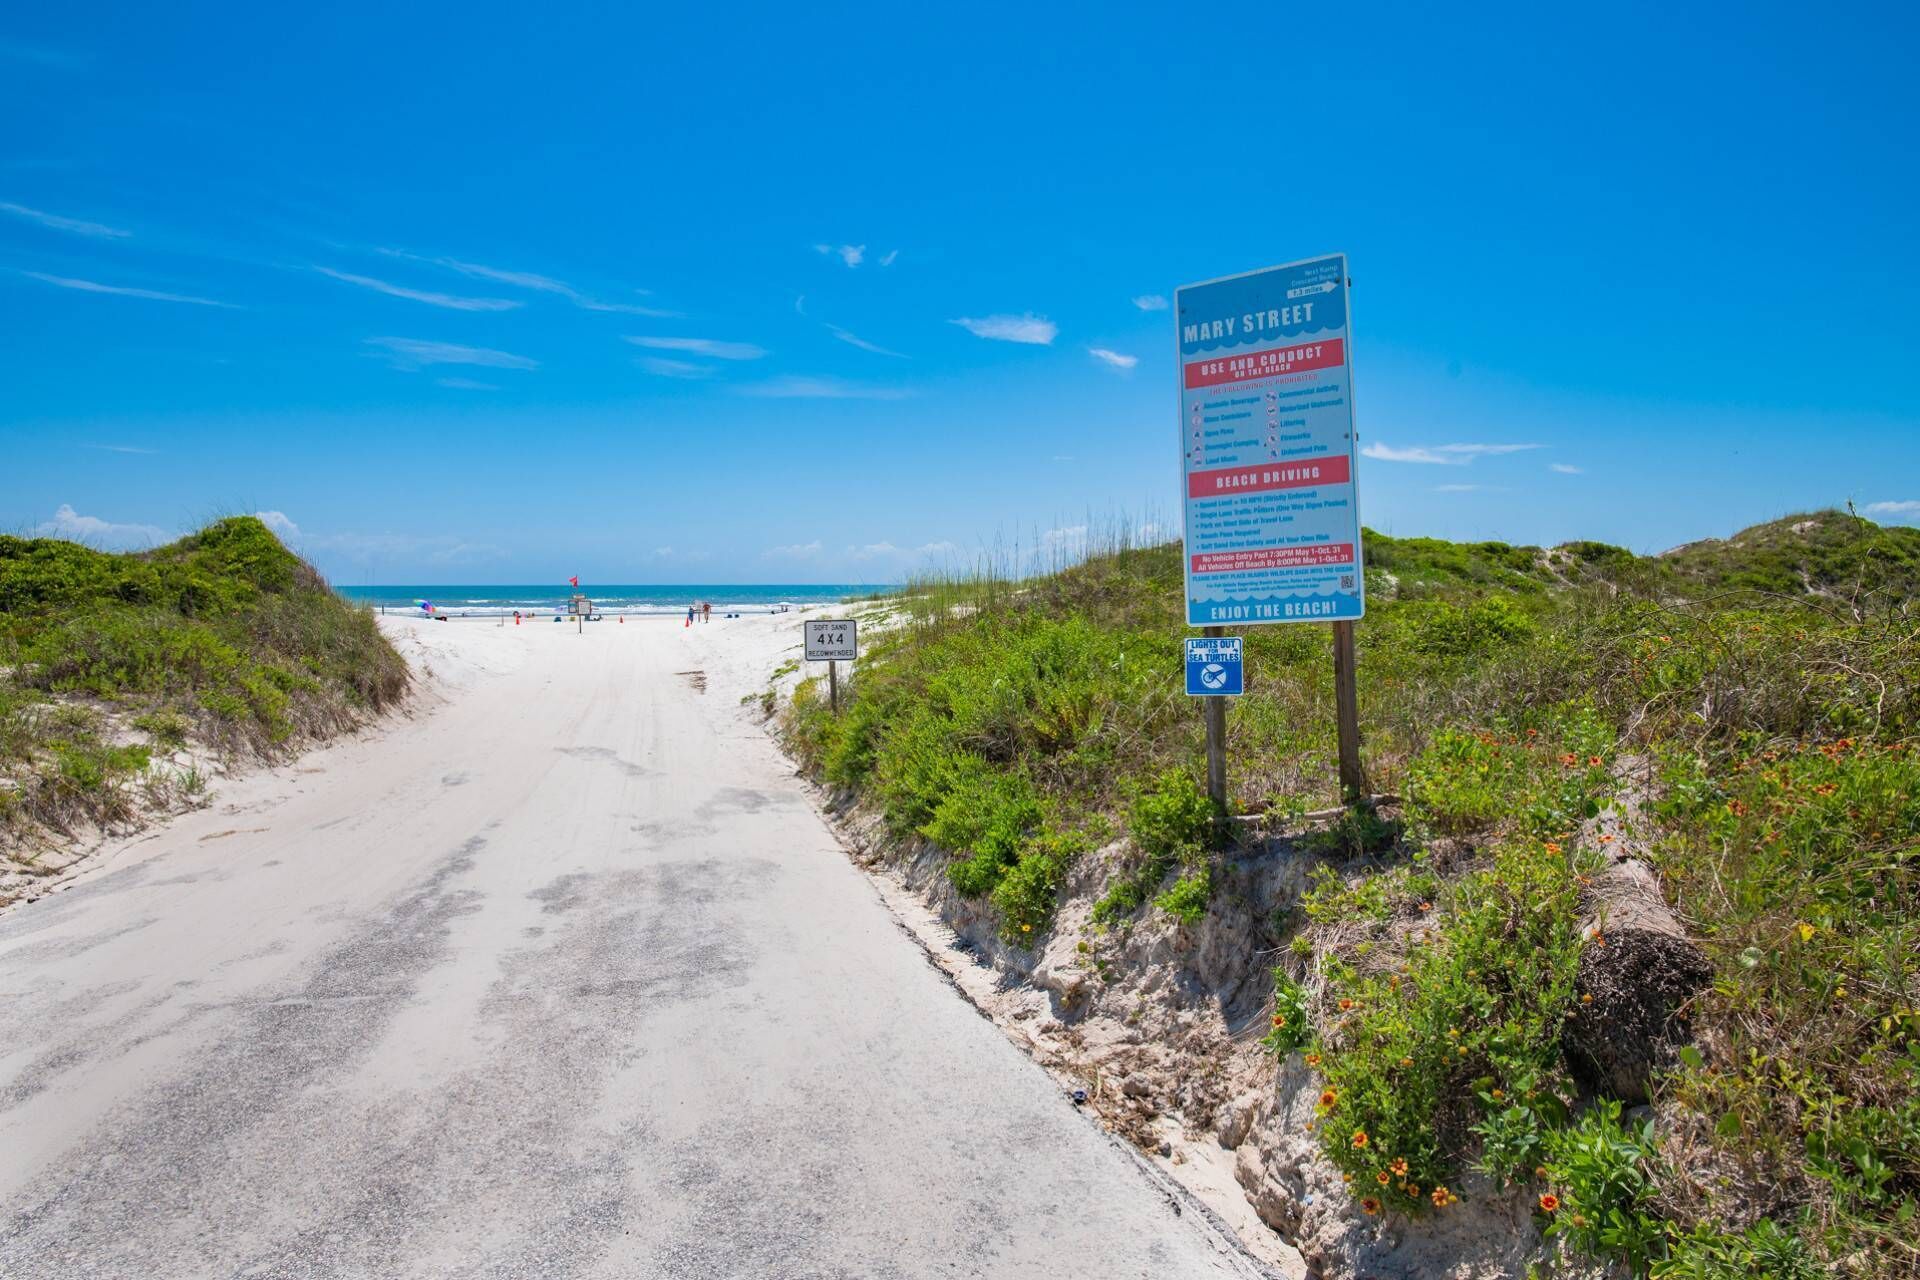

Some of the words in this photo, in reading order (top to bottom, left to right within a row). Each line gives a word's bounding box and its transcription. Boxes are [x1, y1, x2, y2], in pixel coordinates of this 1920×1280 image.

[1184, 317, 1236, 343] MARY
[1243, 302, 1314, 333] STREET
[1201, 362, 1225, 376] USE
[1230, 357, 1254, 371] AND
[1261, 346, 1322, 367] CONDUCT
[1235, 370, 1245, 378] ON
[1248, 368, 1262, 376] THE
[1265, 363, 1291, 374] BEACH
[1280, 419, 1305, 428] Littering
[1216, 473, 1257, 489] BEACH
[1263, 467, 1320, 484] DRIVING
[1198, 563, 1207, 571] All
[1207, 561, 1234, 570] Vehicles
[1234, 560, 1246, 569] Off
[1246, 558, 1266, 568] Beach
[1266, 557, 1276, 567] By
[1276, 556, 1301, 566] 8:00PM
[1302, 555, 1317, 565] May
[1340, 553, 1349, 562] 31
[1212, 553, 1235, 562] Vehicle
[1235, 552, 1253, 561] Entry
[1254, 551, 1268, 559] Past
[1269, 548, 1294, 558] 7:30PM
[1295, 547, 1310, 556] May
[1332, 545, 1341, 554] 31
[1211, 606, 1250, 620] ENJOY
[1255, 604, 1280, 617] THE
[1285, 601, 1337, 616] BEACH!
[808, 649, 854, 657] RECOMMENDED
[1191, 640, 1218, 649] LIGHTS
[1220, 640, 1235, 648] OUT
[1189, 654, 1203, 662] SEA
[1206, 654, 1239, 662] TURTLES
